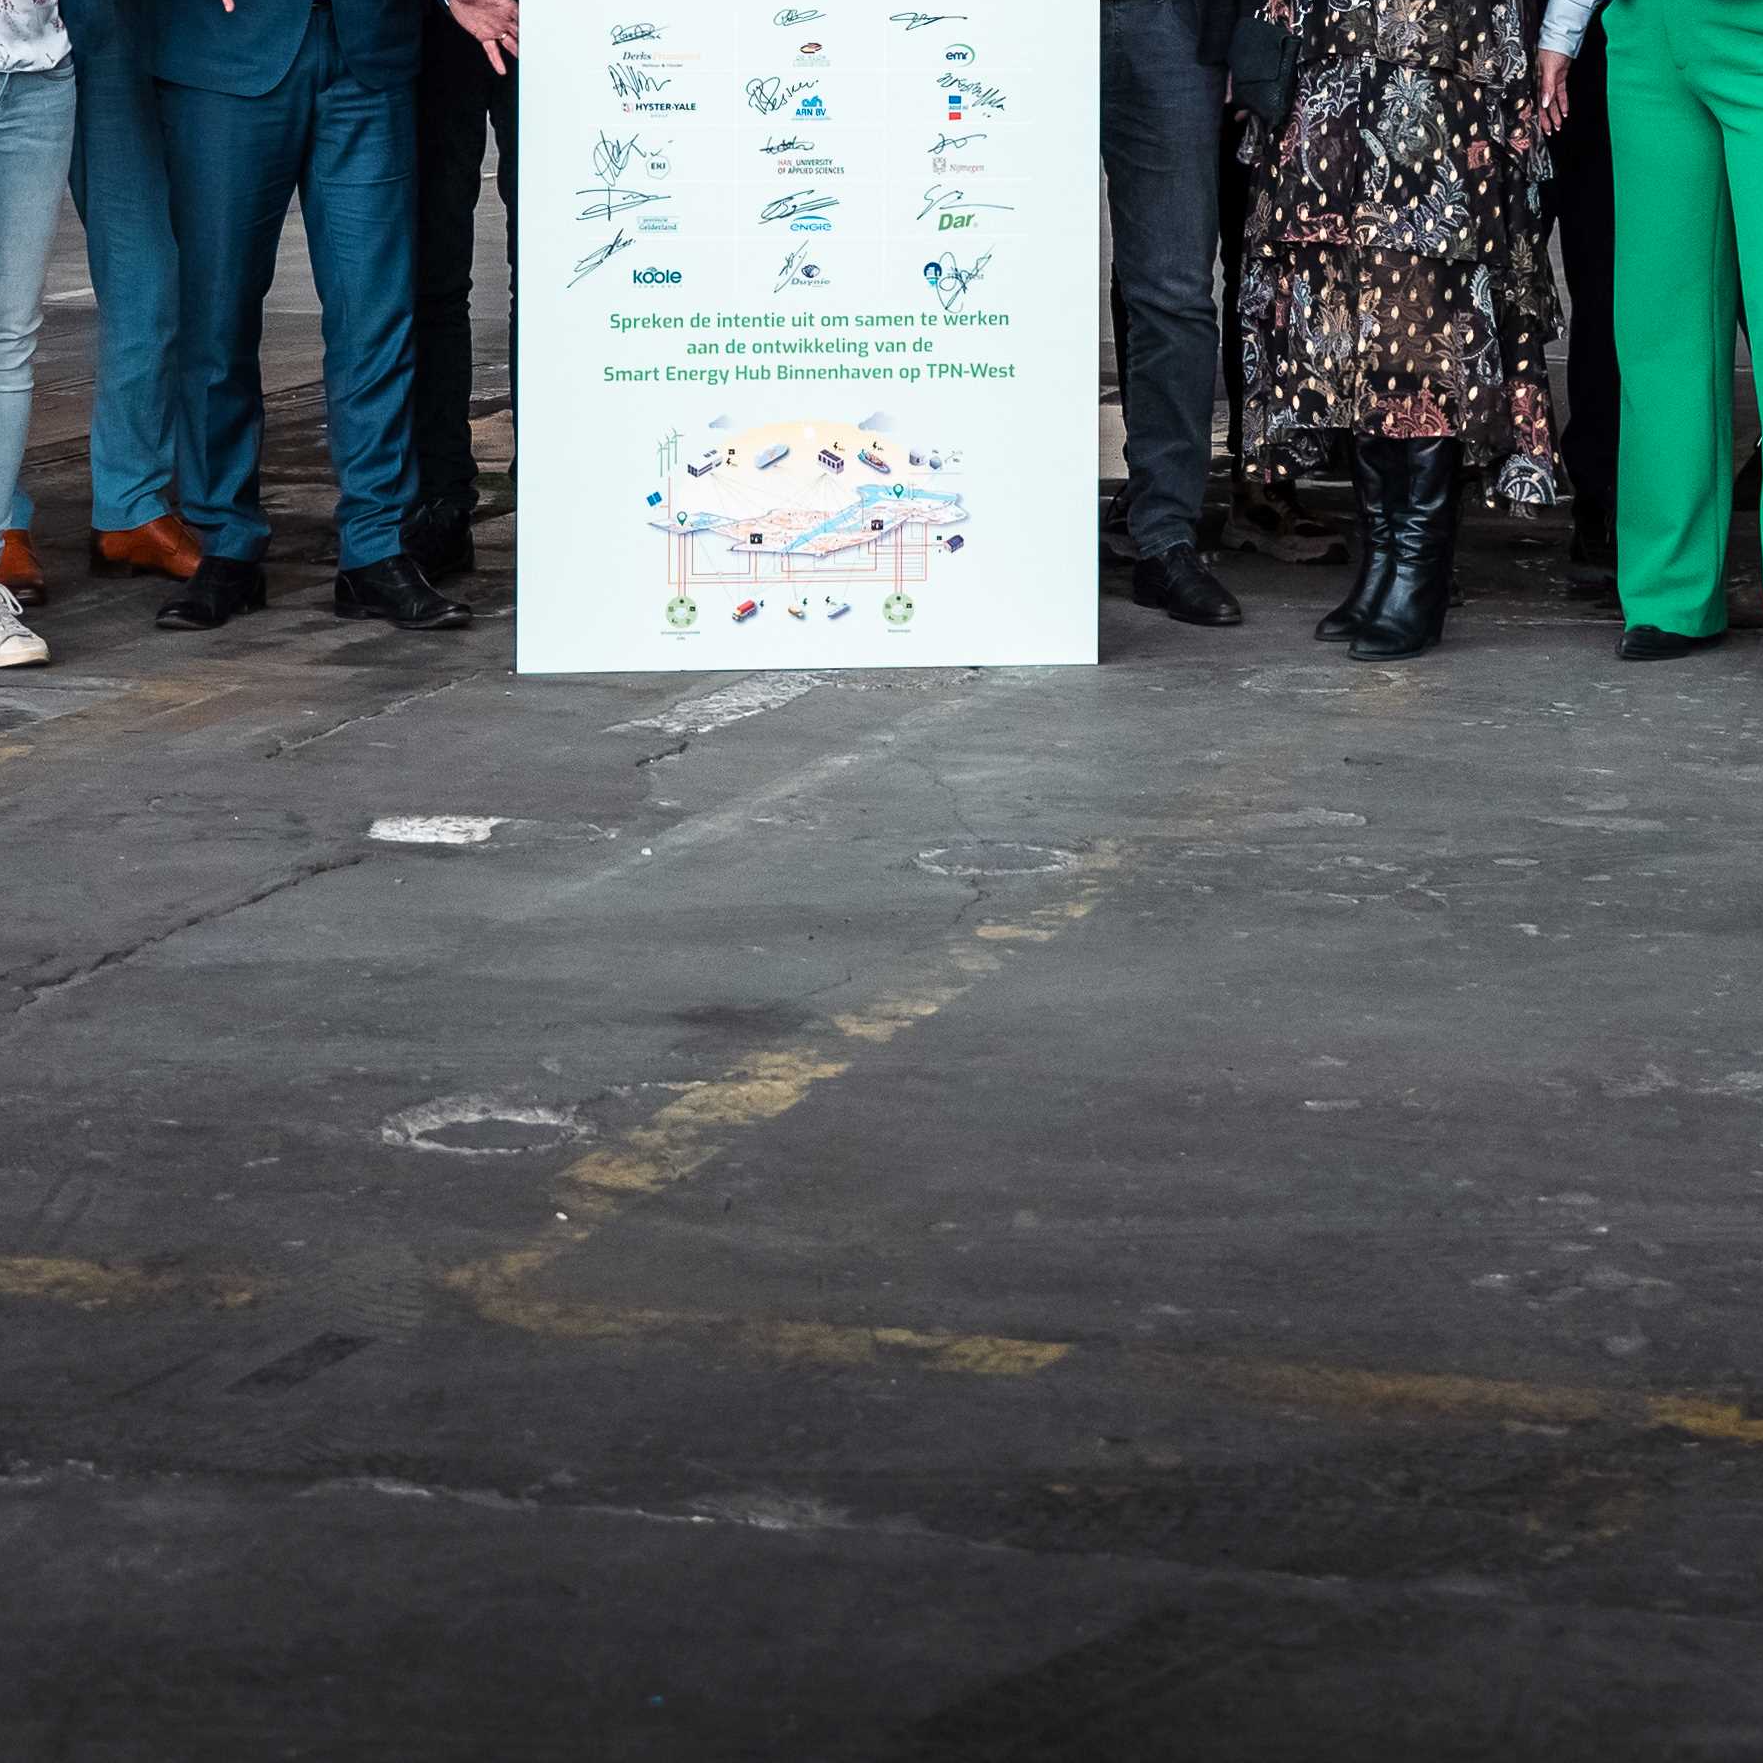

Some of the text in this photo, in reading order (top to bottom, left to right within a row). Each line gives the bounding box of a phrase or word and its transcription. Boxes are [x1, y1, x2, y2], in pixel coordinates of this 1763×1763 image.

[610, 310, 1009, 333] Spreken de intentie uit om samen te werken
[687, 337, 932, 358] aan de ontwikkeling van de
[604, 363, 1015, 385] Smart Energy Hub Binnenhaven op TPN-West
